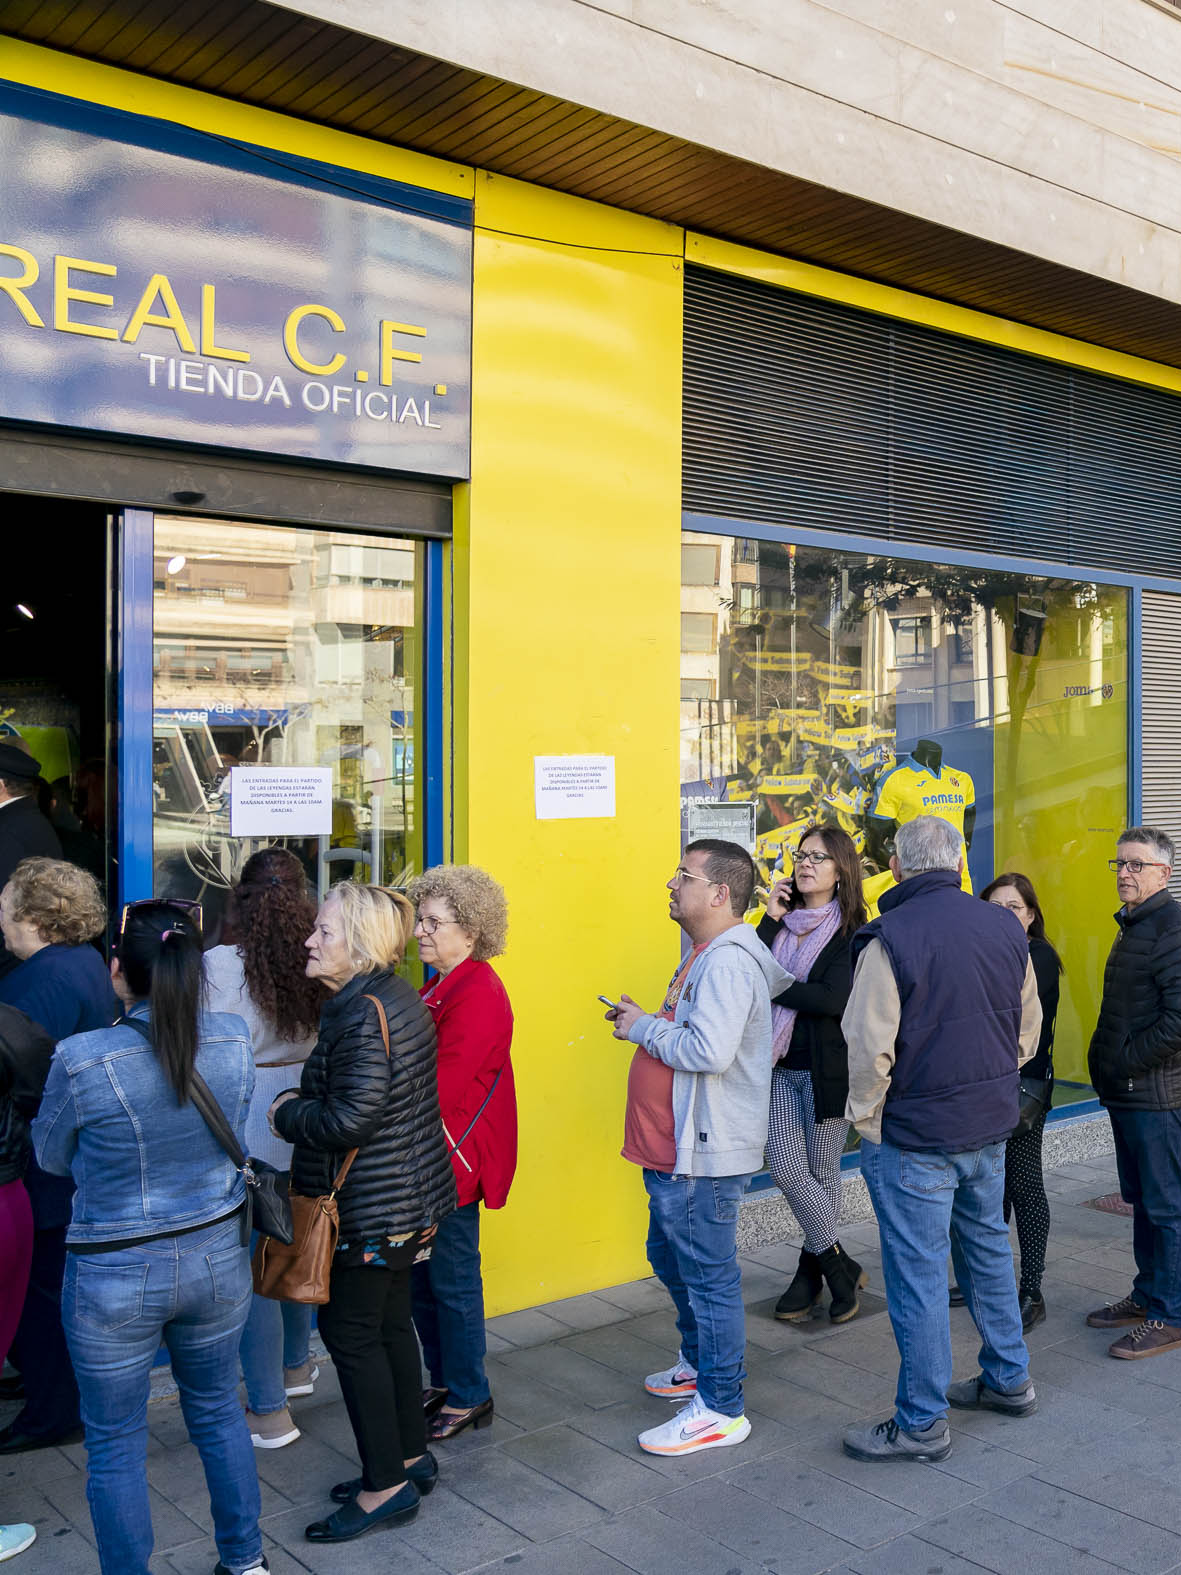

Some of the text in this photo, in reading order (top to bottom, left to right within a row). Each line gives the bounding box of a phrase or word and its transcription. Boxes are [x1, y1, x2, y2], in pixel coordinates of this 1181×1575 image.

[0, 244, 448, 396] REAL C.F.
[140, 352, 441, 429] TIENDA OFICIAL
[922, 794, 964, 806] PAMESA
